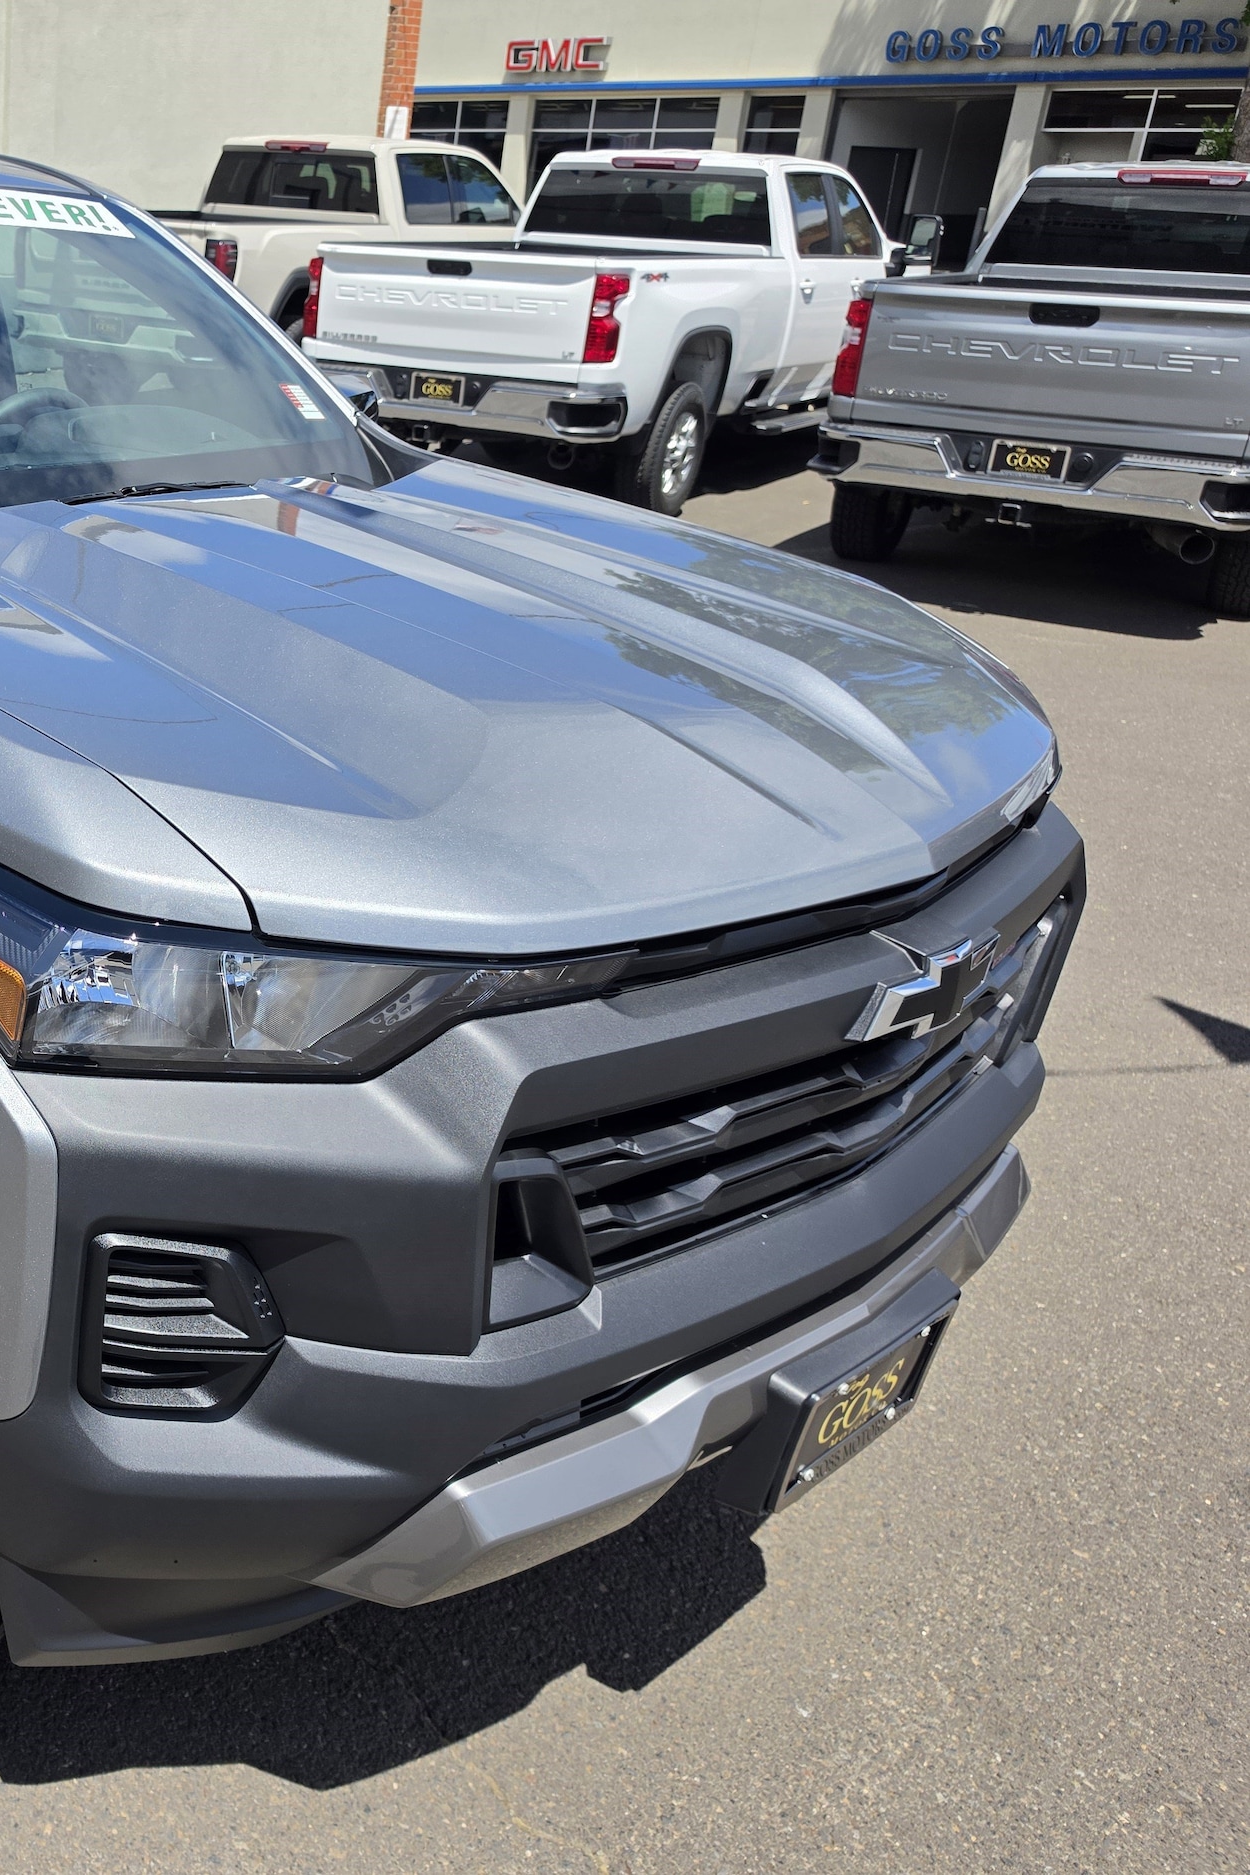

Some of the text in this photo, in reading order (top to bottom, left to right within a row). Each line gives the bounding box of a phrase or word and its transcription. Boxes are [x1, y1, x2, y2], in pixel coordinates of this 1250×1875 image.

[505, 36, 608, 72] GMC
[884, 17, 1241, 64] GOSS MOTORS
[334, 284, 569, 316] CHEVROLET
[887, 332, 1241, 376] CHEVROLET
[421, 382, 454, 397] GOSS
[1006, 452, 1050, 470] GOSS
[818, 1358, 905, 1444] GOSS
